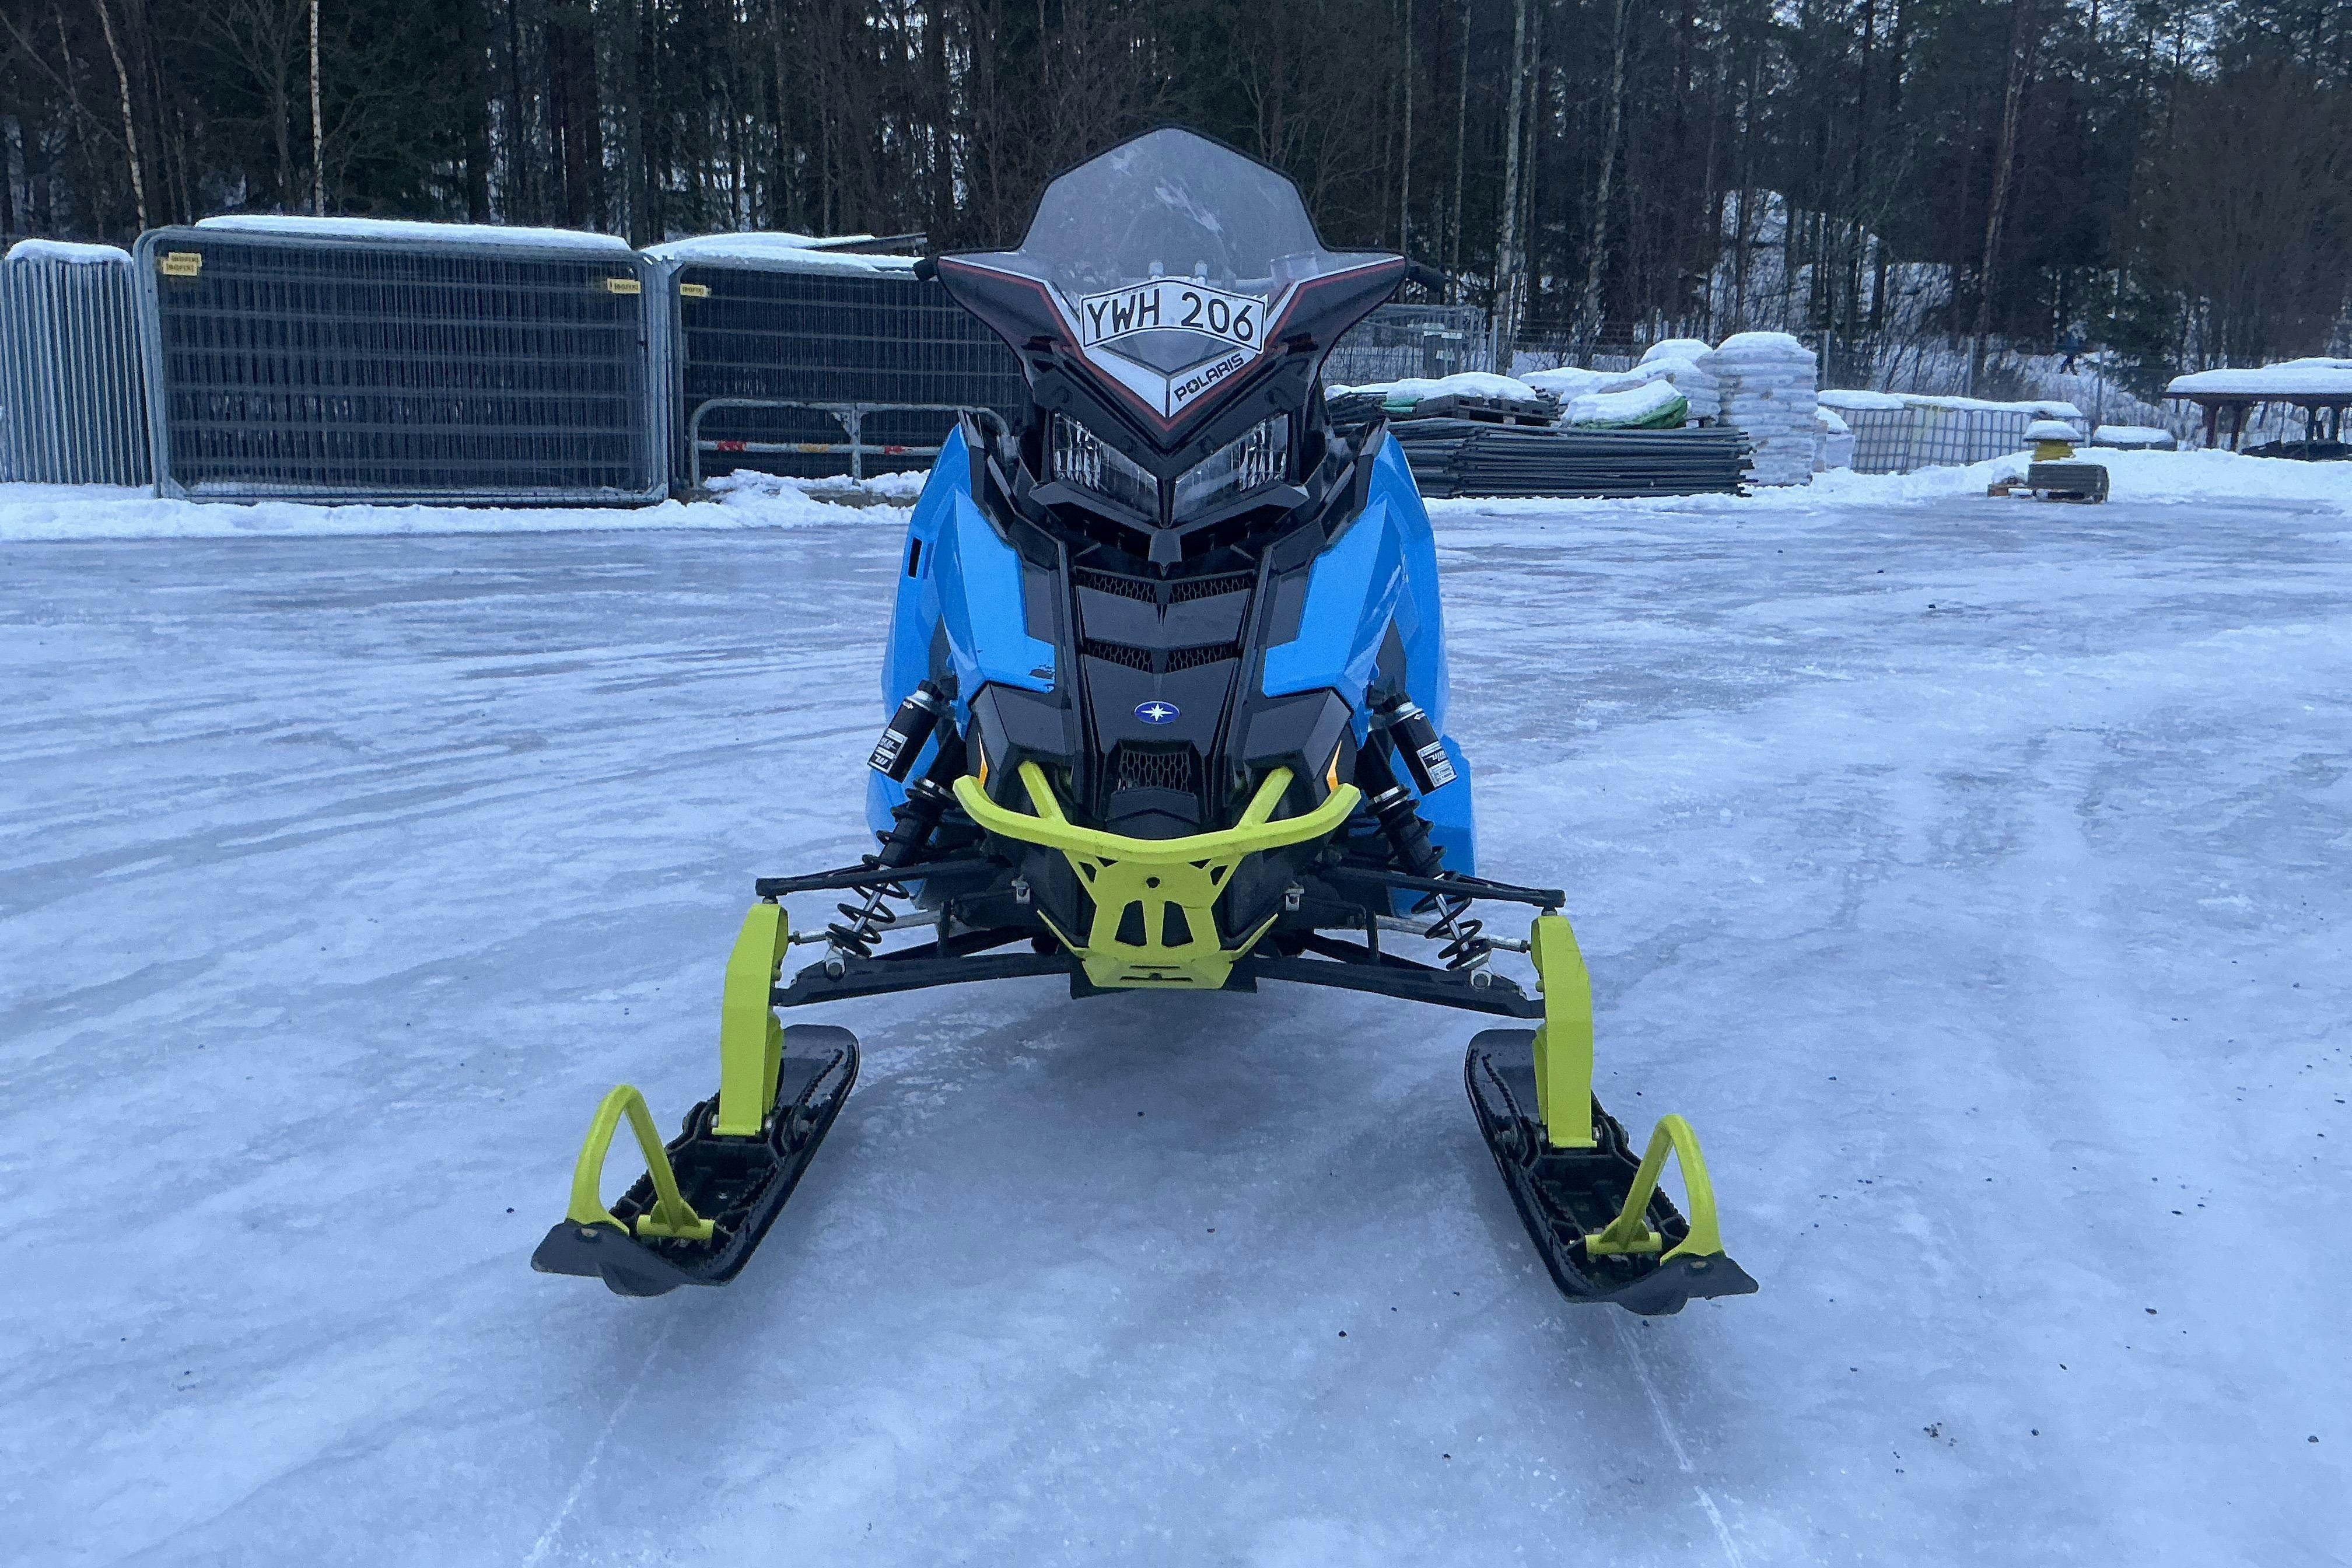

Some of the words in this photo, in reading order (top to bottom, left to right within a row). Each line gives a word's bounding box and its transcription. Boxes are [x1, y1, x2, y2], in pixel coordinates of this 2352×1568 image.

[1087, 289, 1159, 338] YWH
[1182, 292, 1253, 341] 206
[1174, 353, 1244, 401] POLARIS
